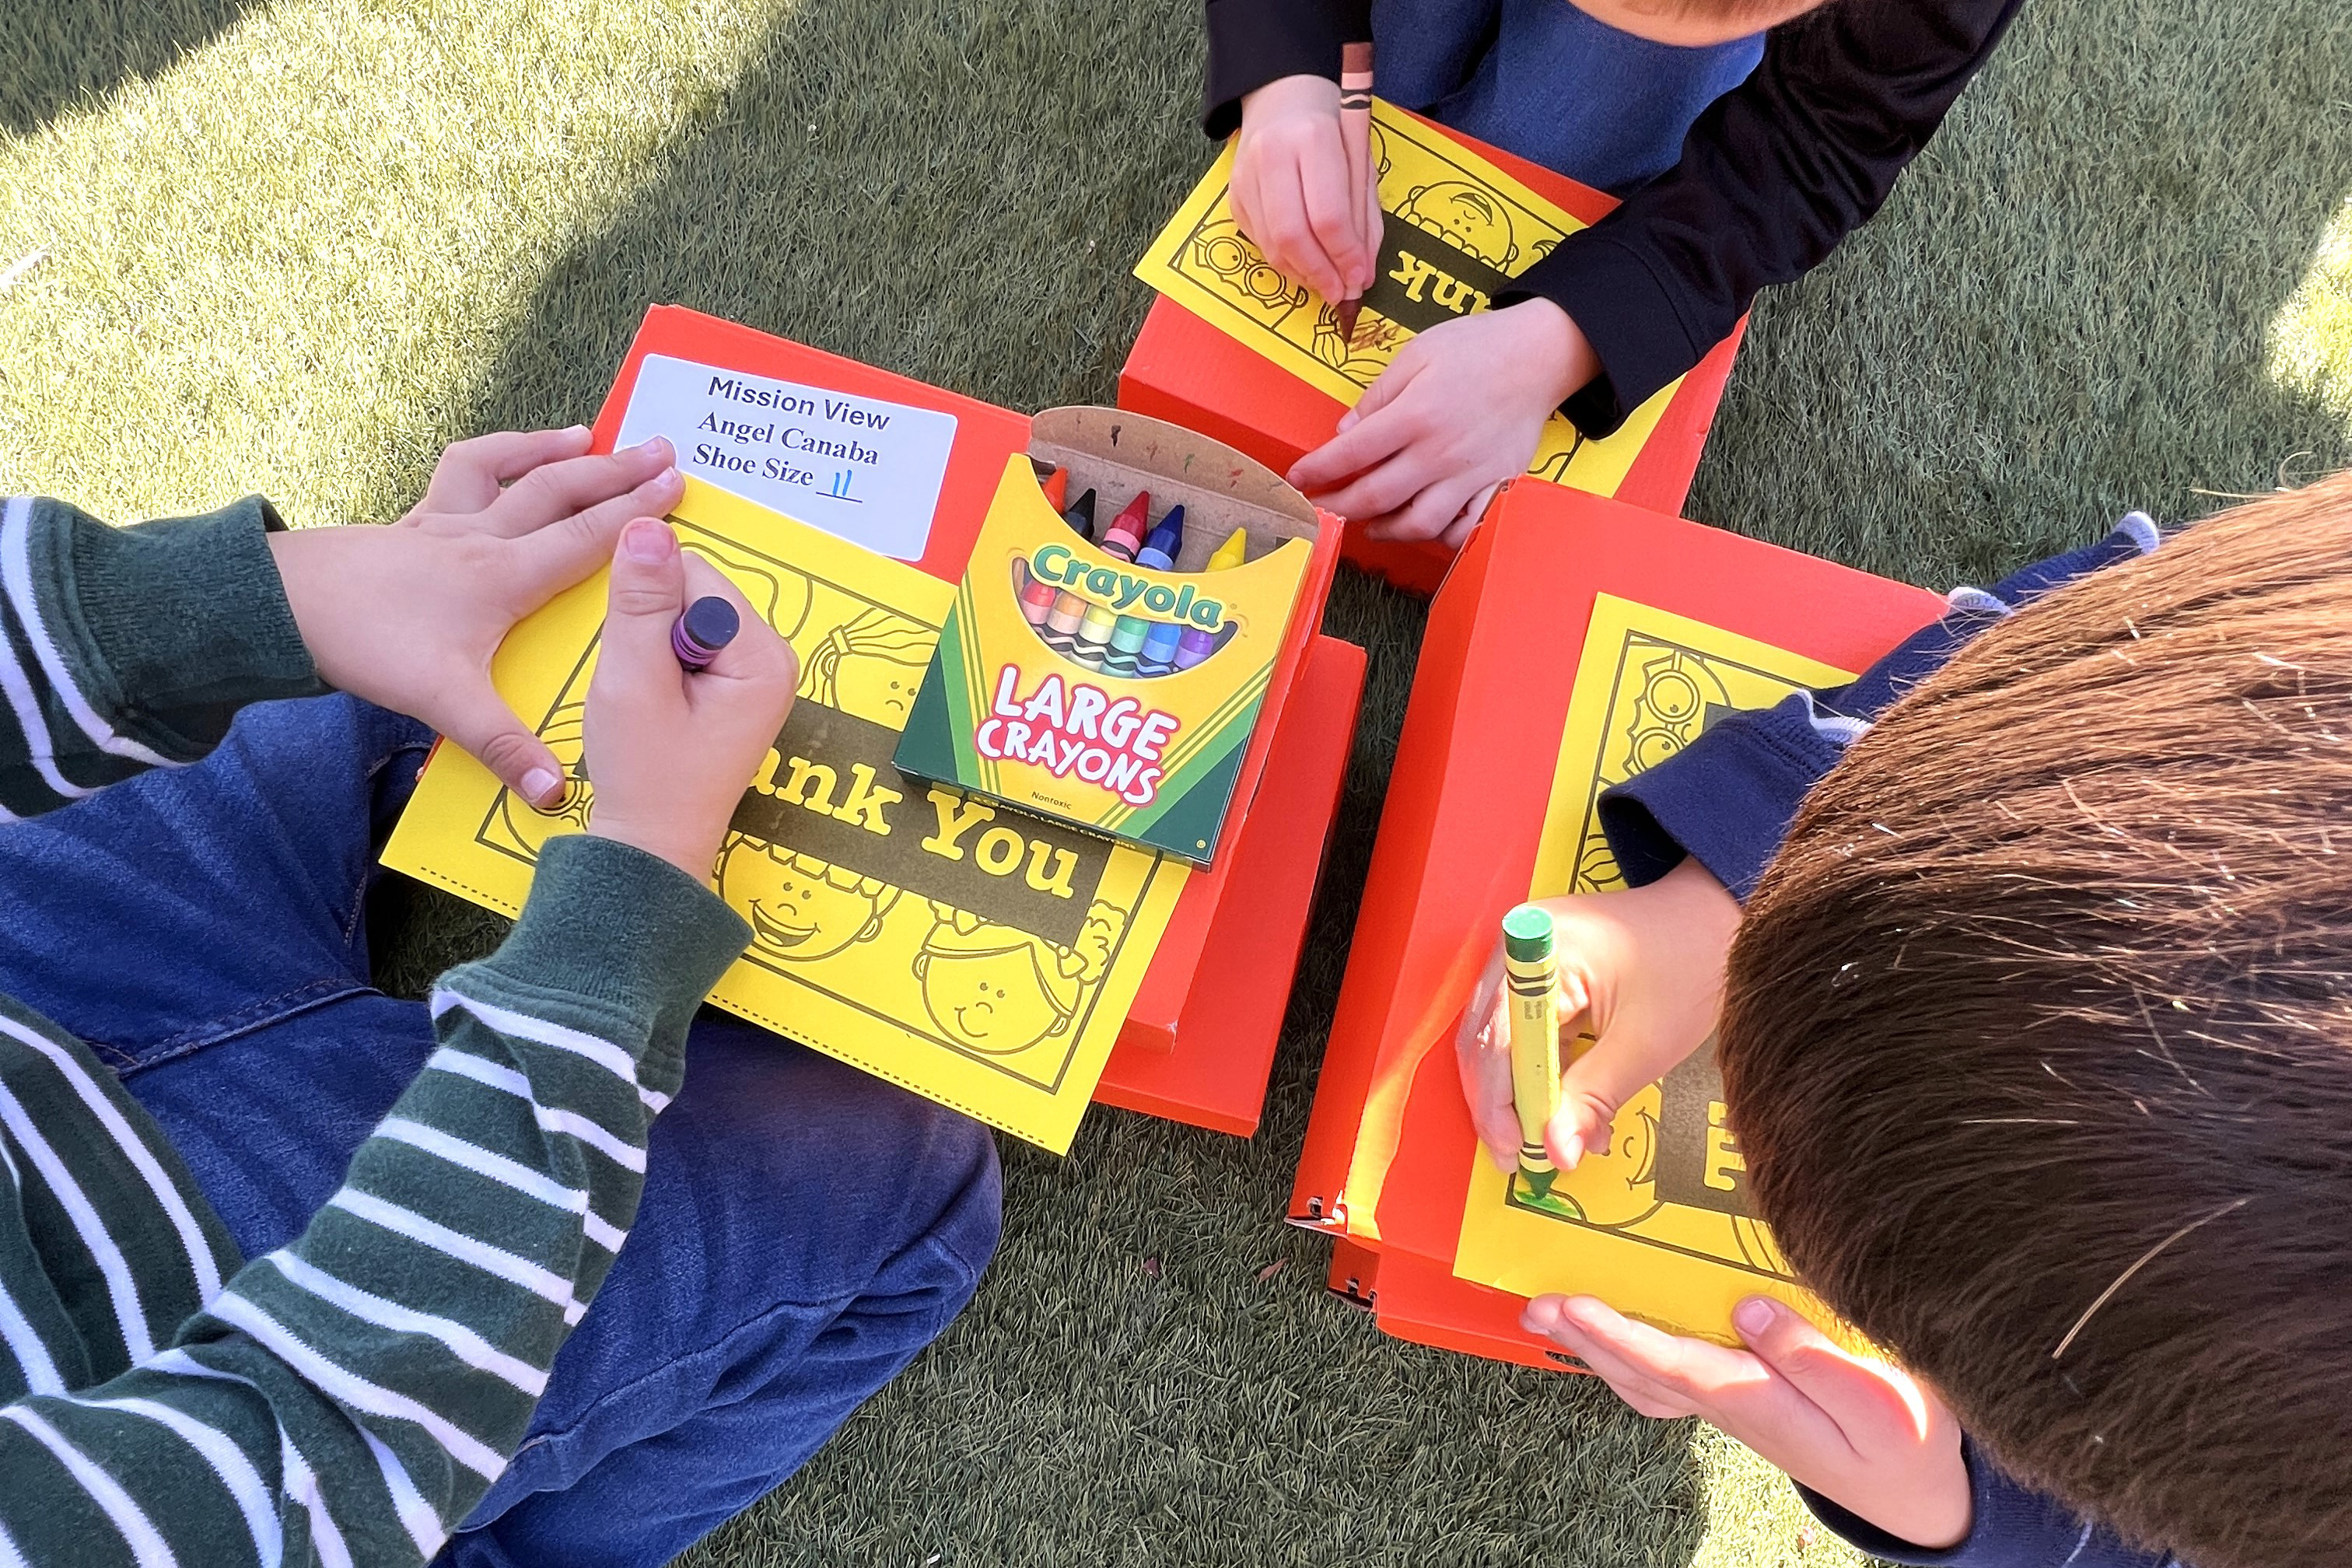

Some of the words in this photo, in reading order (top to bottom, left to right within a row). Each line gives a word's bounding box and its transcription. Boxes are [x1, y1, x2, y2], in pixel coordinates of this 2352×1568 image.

[708, 376, 815, 416] Mission
[824, 398, 891, 431] View
[692, 443, 757, 474] Shoe
[761, 460, 814, 487] Size
[697, 411, 775, 445] Angel
[781, 427, 879, 466] Canaba
[1033, 545, 1223, 628] Crayola
[992, 664, 1179, 762] LARGE
[976, 718, 1162, 806] CRAYONS
[1031, 790, 1073, 810] Nontoxic
[921, 788, 1079, 899] You
